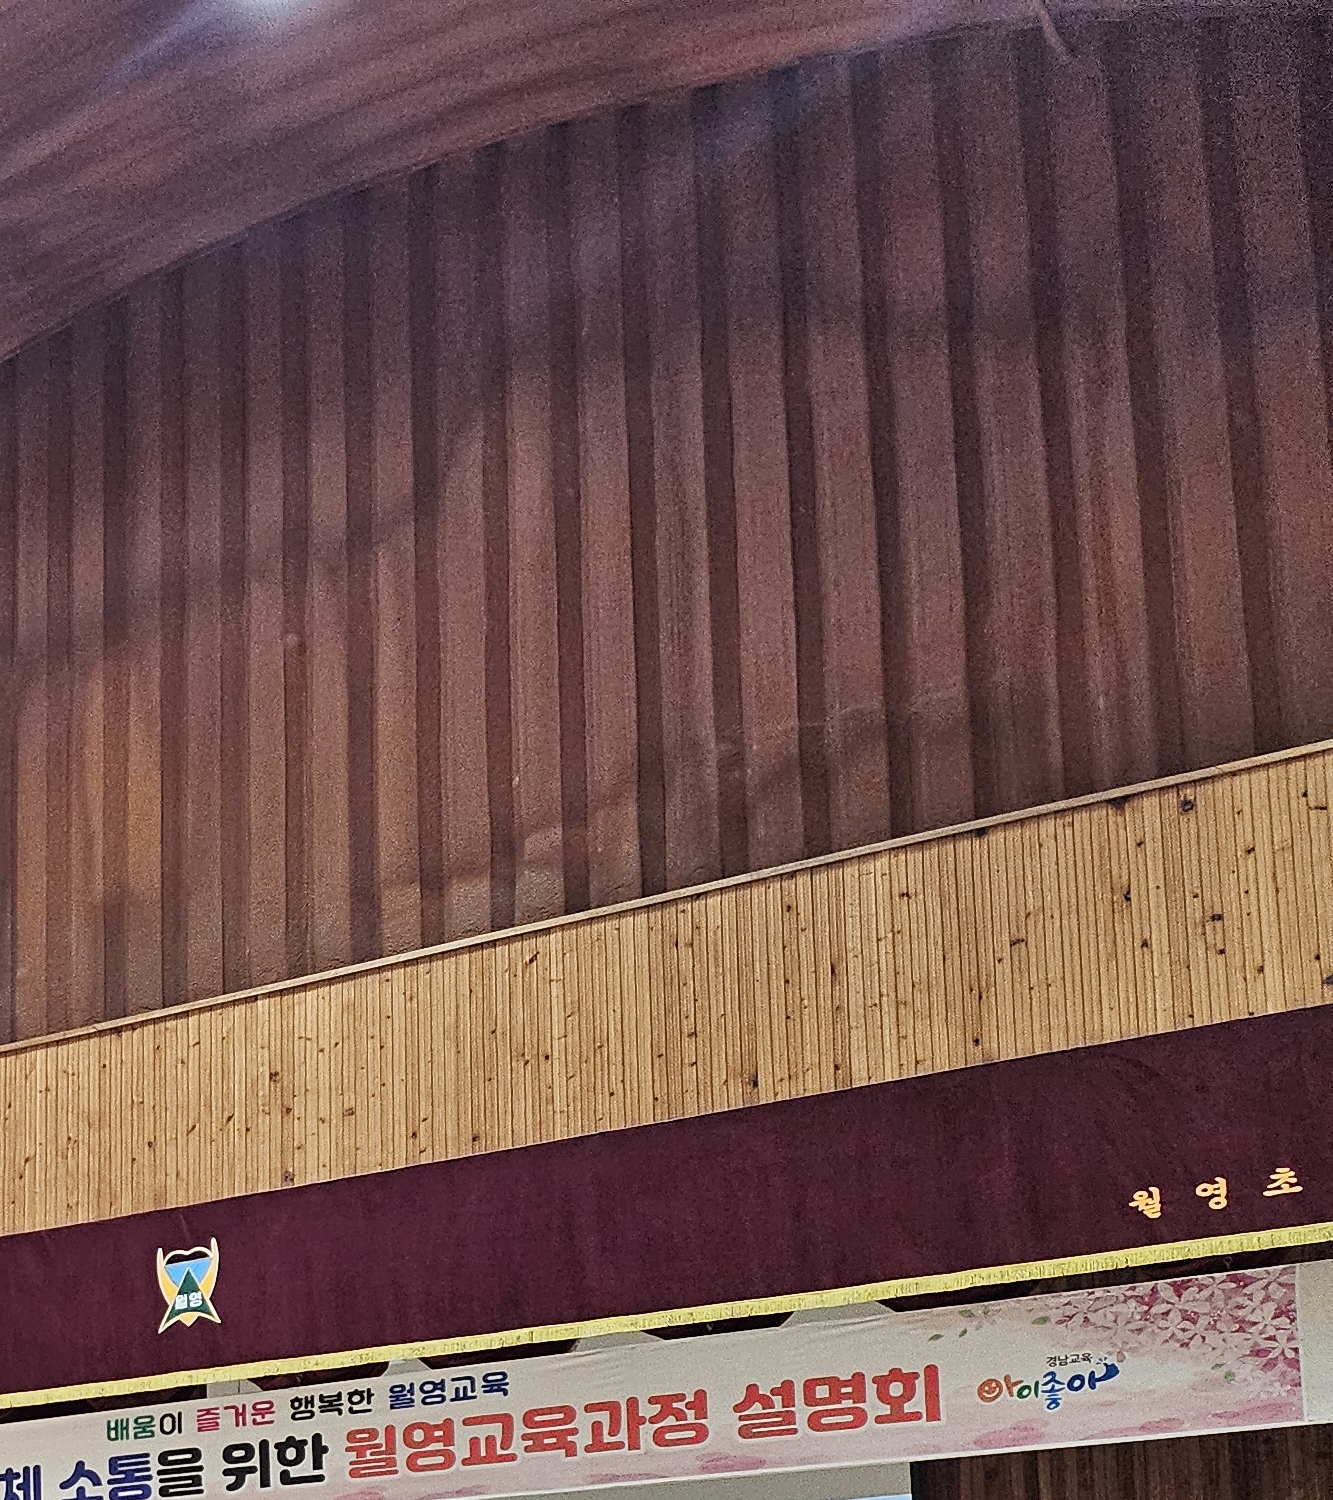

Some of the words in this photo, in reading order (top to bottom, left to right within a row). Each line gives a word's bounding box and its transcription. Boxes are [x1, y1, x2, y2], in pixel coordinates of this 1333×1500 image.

[977, 1363, 1120, 1410] 아이좋아
[1046, 1353, 1093, 1367] 경남교육
[106, 1411, 183, 1442] 배움이
[196, 1400, 277, 1433] 즐거운
[289, 1387, 375, 1421] 행복한
[388, 1370, 510, 1410] 월영교육
[221, 1432, 330, 1492] 위한
[344, 1388, 712, 1480] 월영교육과정
[732, 1363, 941, 1441] 설명회
